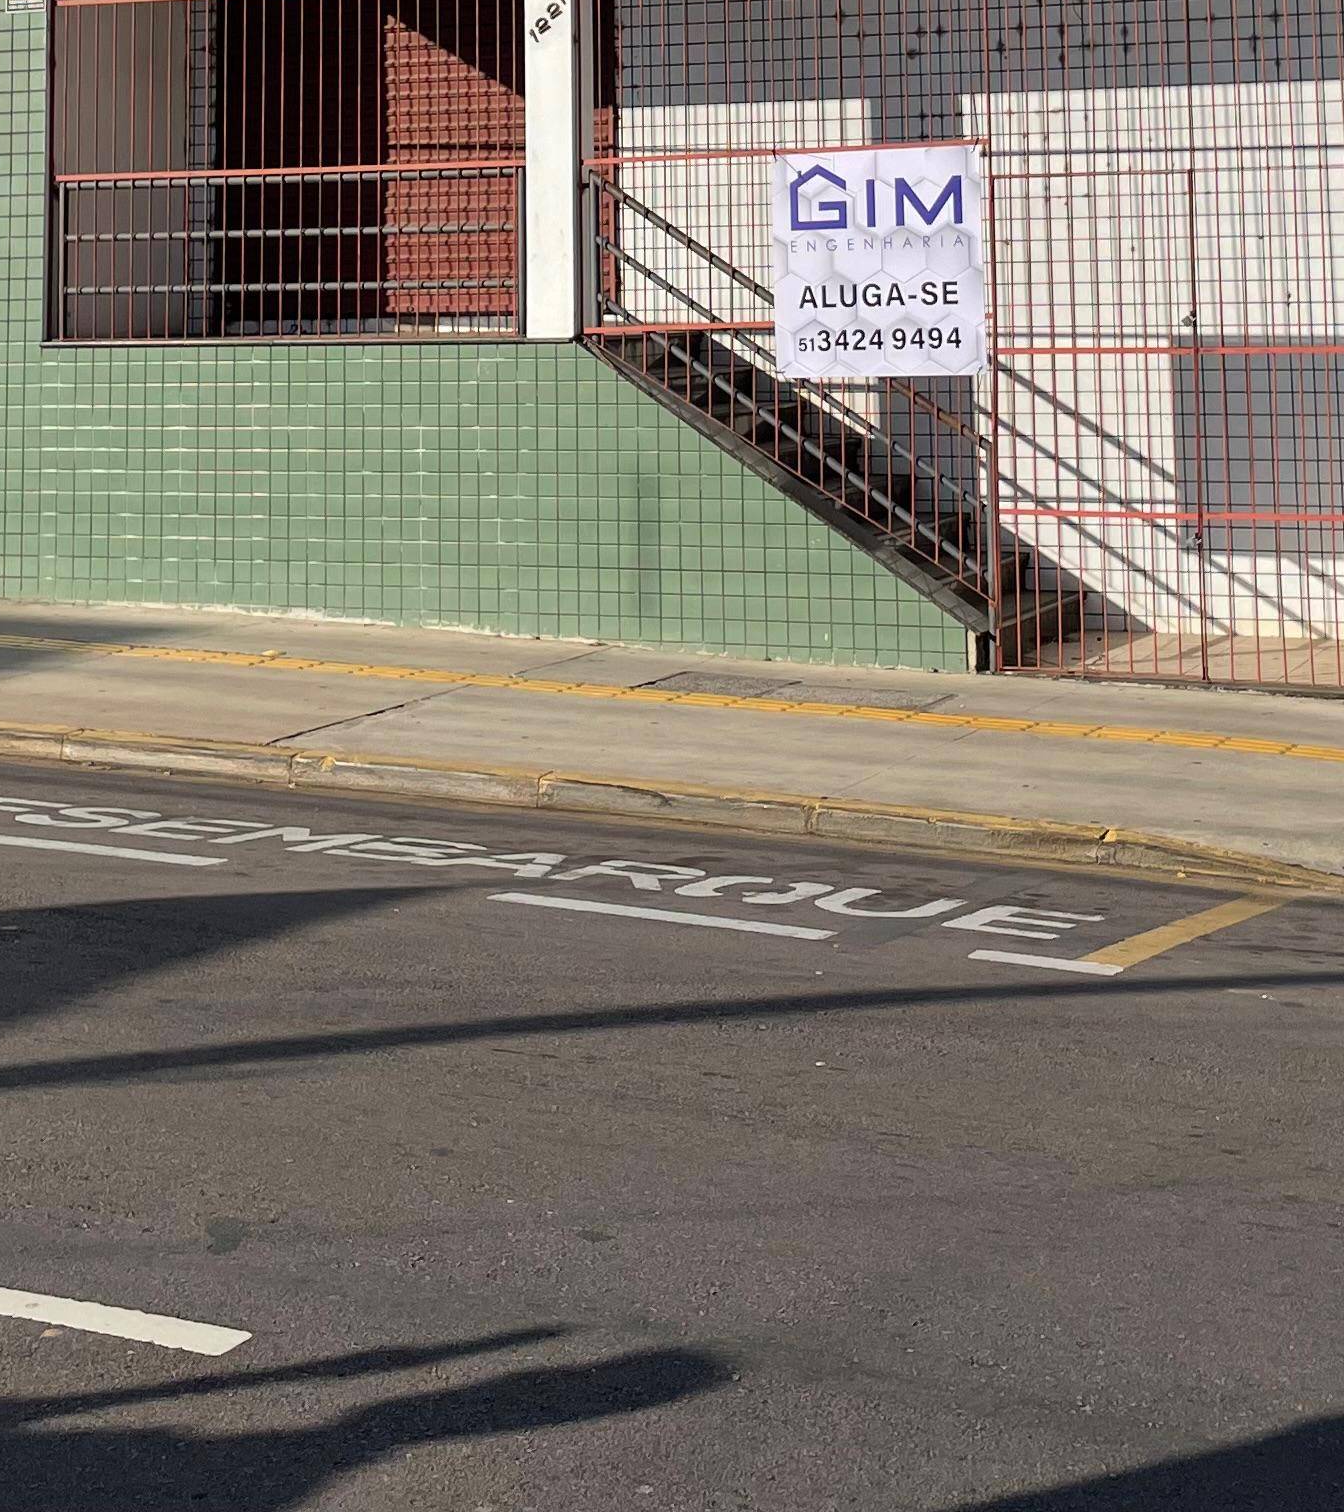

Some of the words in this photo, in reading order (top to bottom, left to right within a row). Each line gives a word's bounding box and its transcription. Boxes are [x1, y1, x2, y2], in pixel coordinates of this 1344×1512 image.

[790, 164, 963, 231] GIM
[790, 235, 964, 253] ENGENHARIA
[799, 281, 959, 309] ALUGA-SE
[892, 327, 962, 350] 9494
